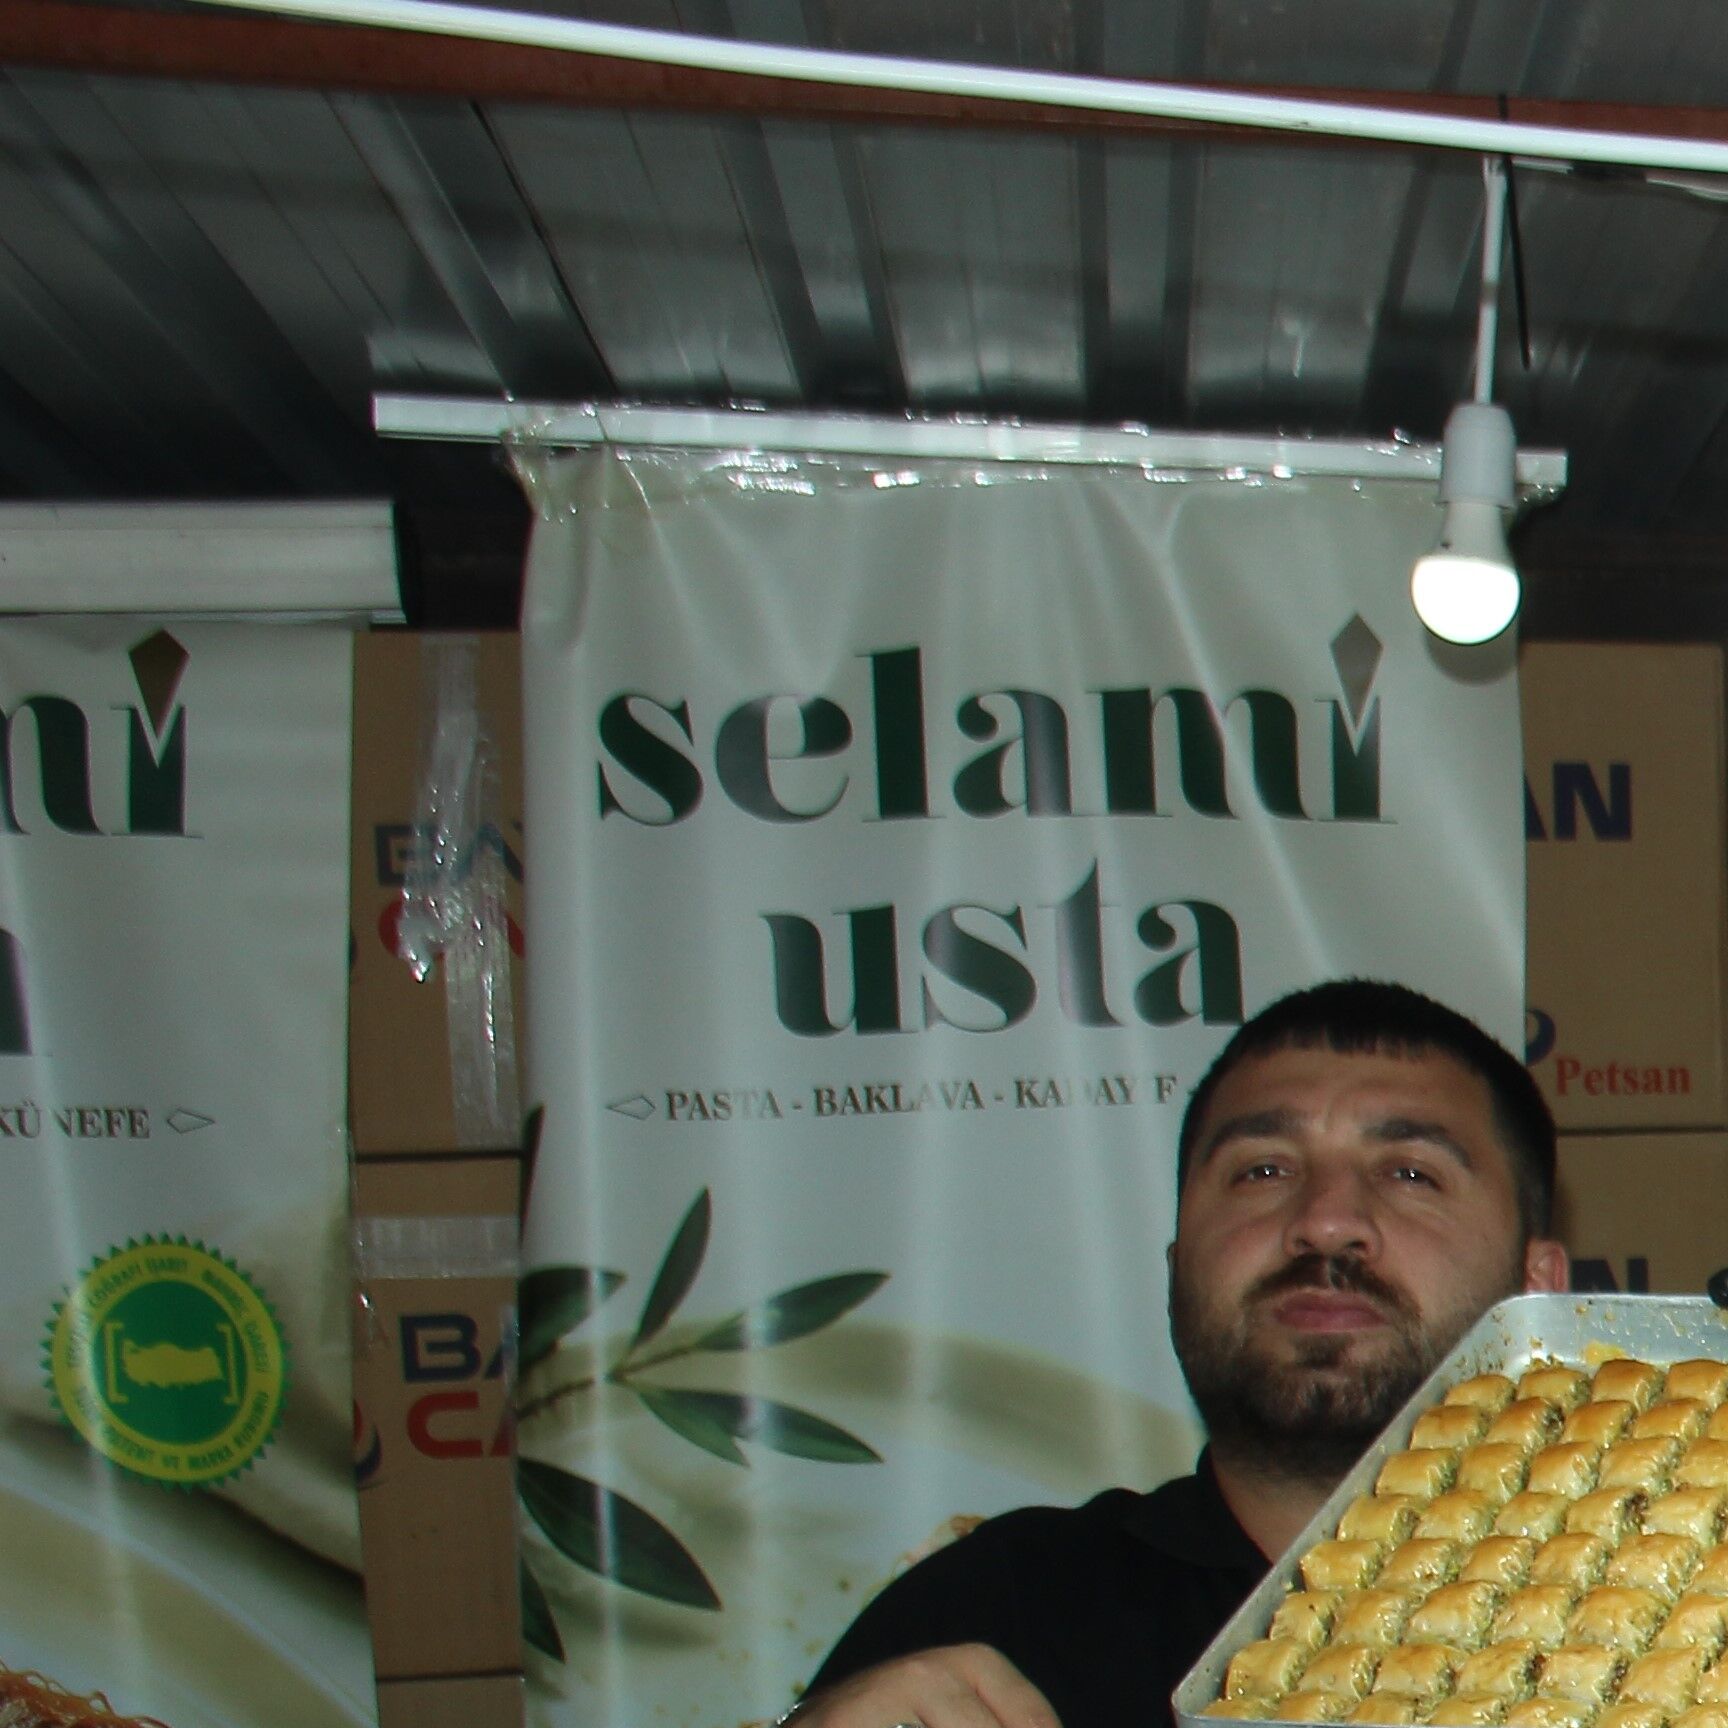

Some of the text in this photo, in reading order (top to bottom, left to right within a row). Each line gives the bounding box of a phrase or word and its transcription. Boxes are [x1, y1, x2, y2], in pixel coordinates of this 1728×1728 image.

[598, 612, 1398, 826] selami
[1523, 763, 1633, 841] N
[762, 857, 1247, 1038] usta
[665, 1089, 783, 1122] PASTA
[1014, 1075, 1178, 1110] KAAYF
[1555, 1056, 1692, 1097] Petsan
